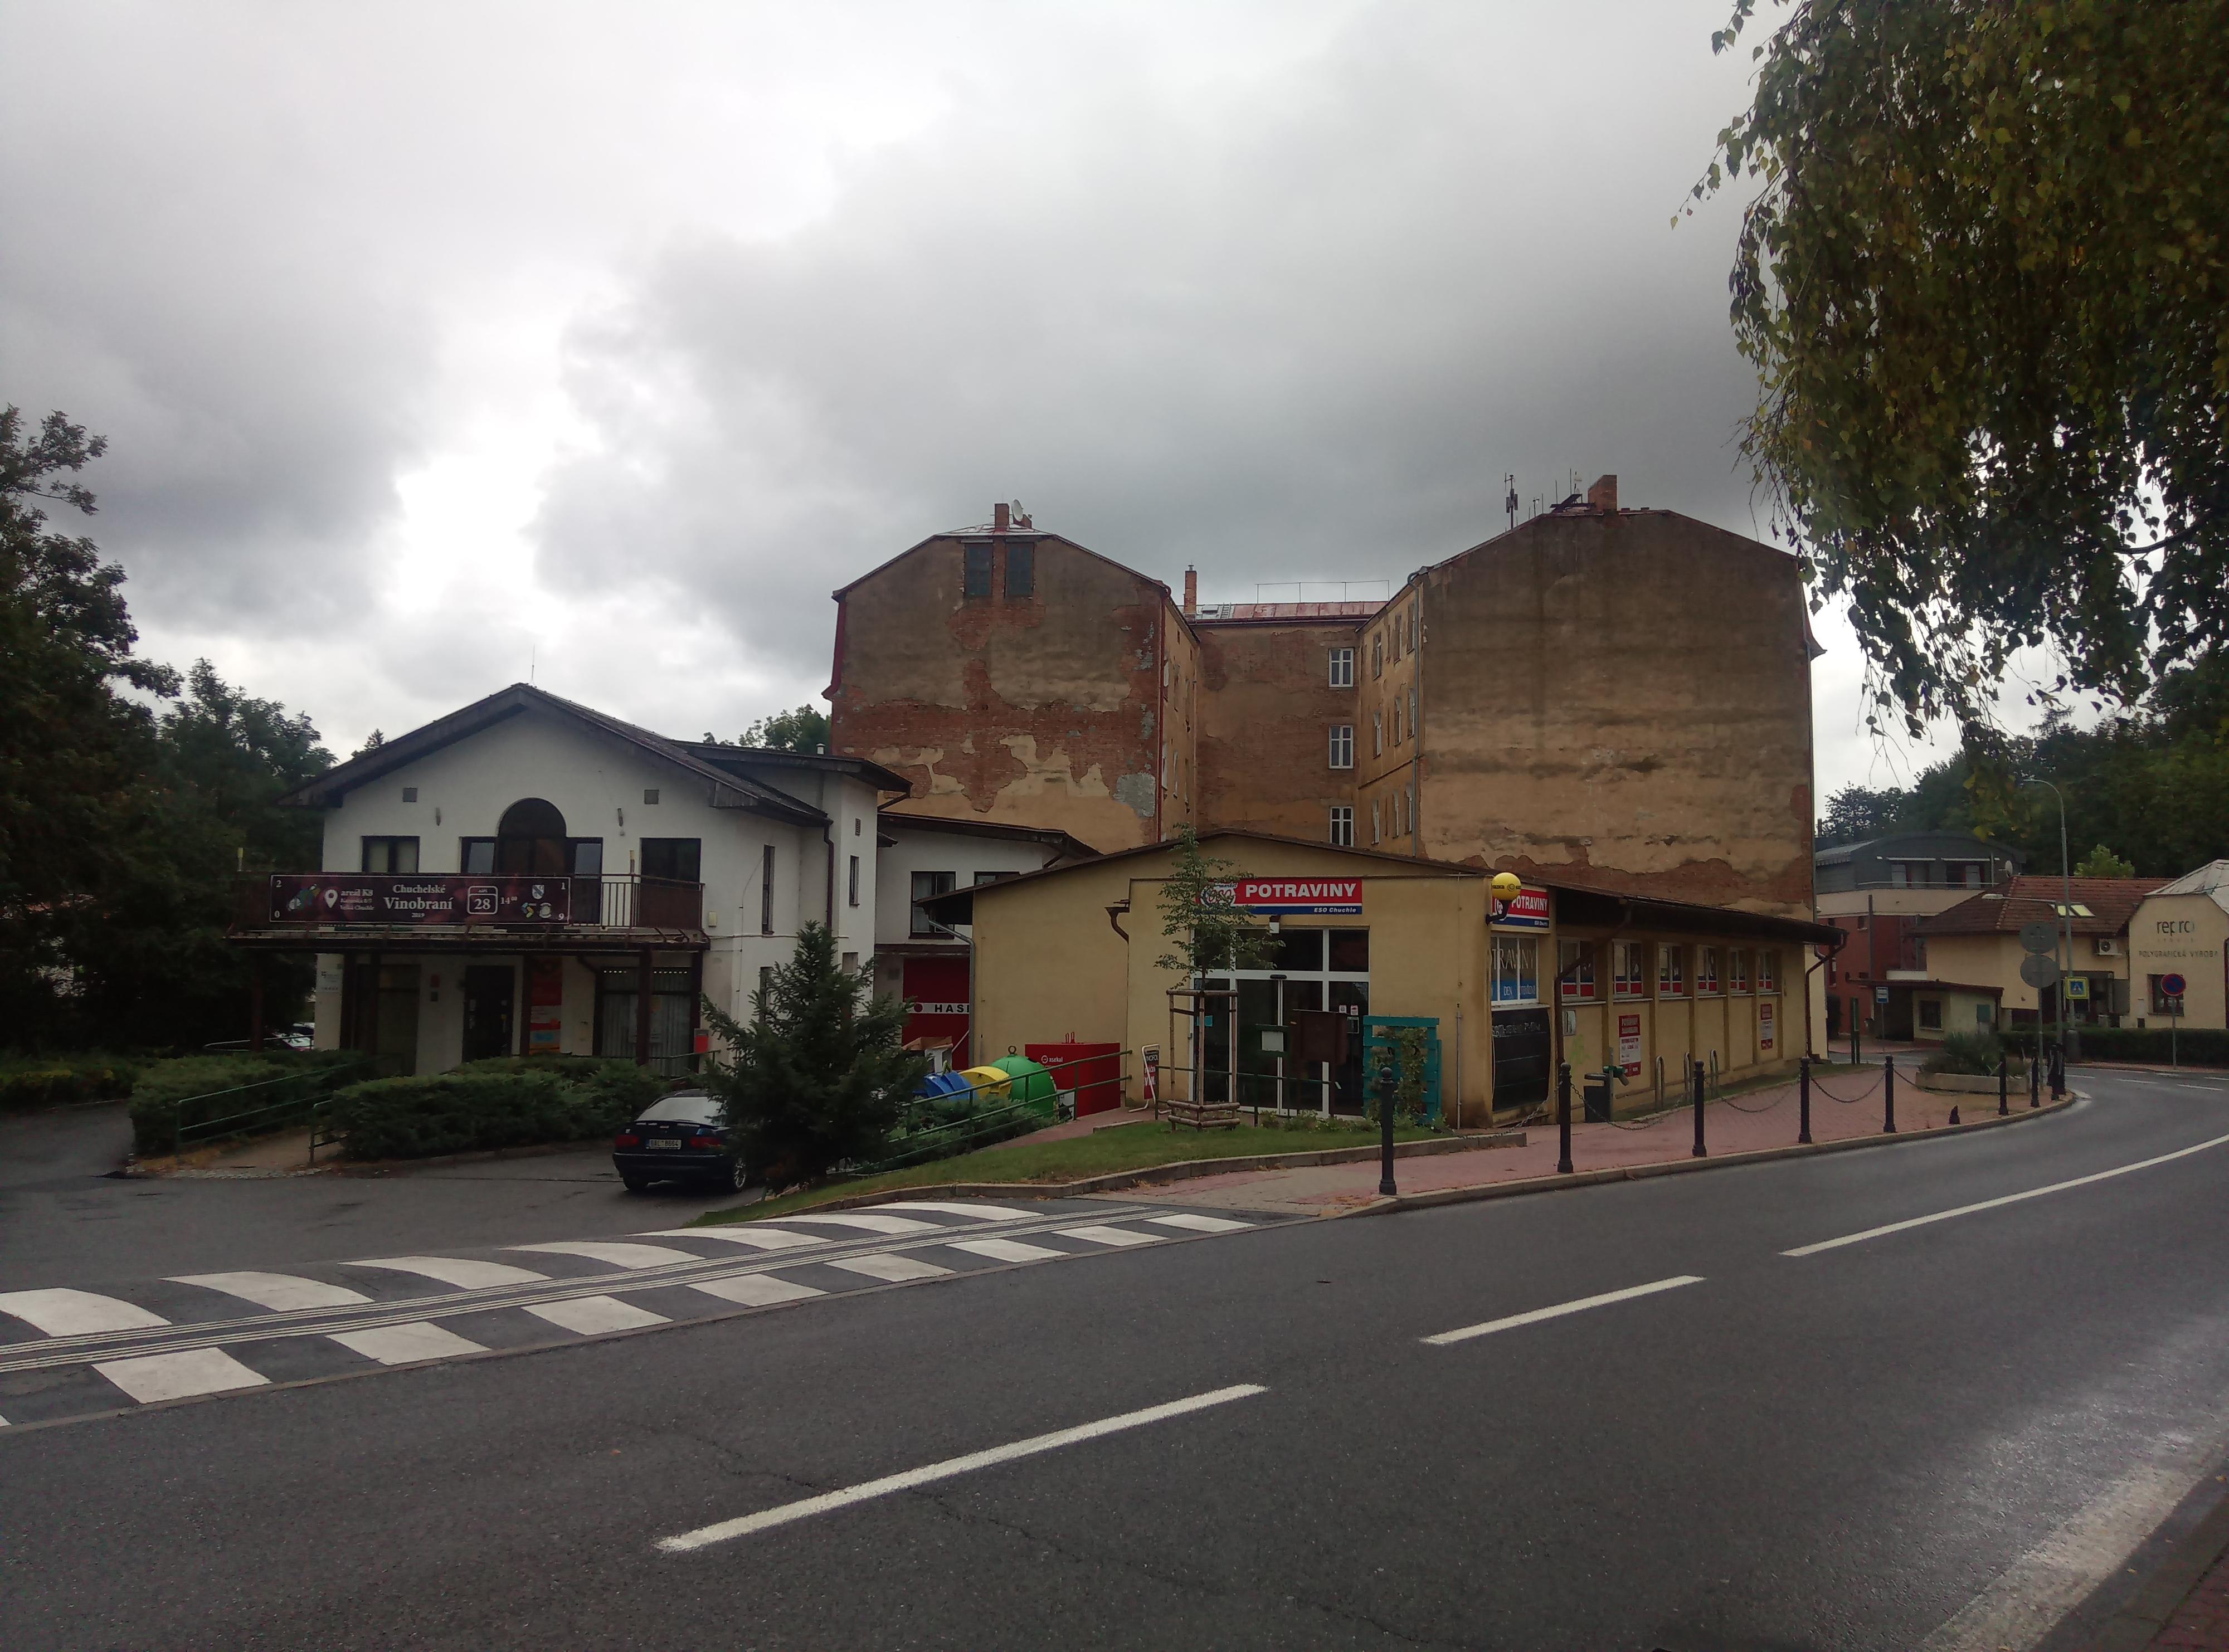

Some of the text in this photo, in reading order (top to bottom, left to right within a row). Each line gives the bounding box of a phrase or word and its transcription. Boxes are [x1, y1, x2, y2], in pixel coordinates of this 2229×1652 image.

[392, 884, 446, 893] Chuchelské
[1245, 883, 1356, 898] POTRAVINY
[383, 896, 454, 910] Vinobraní
[473, 898, 491, 910] 28
[1511, 895, 1548, 912] POTRAVINY
[558, 913, 564, 921] 9
